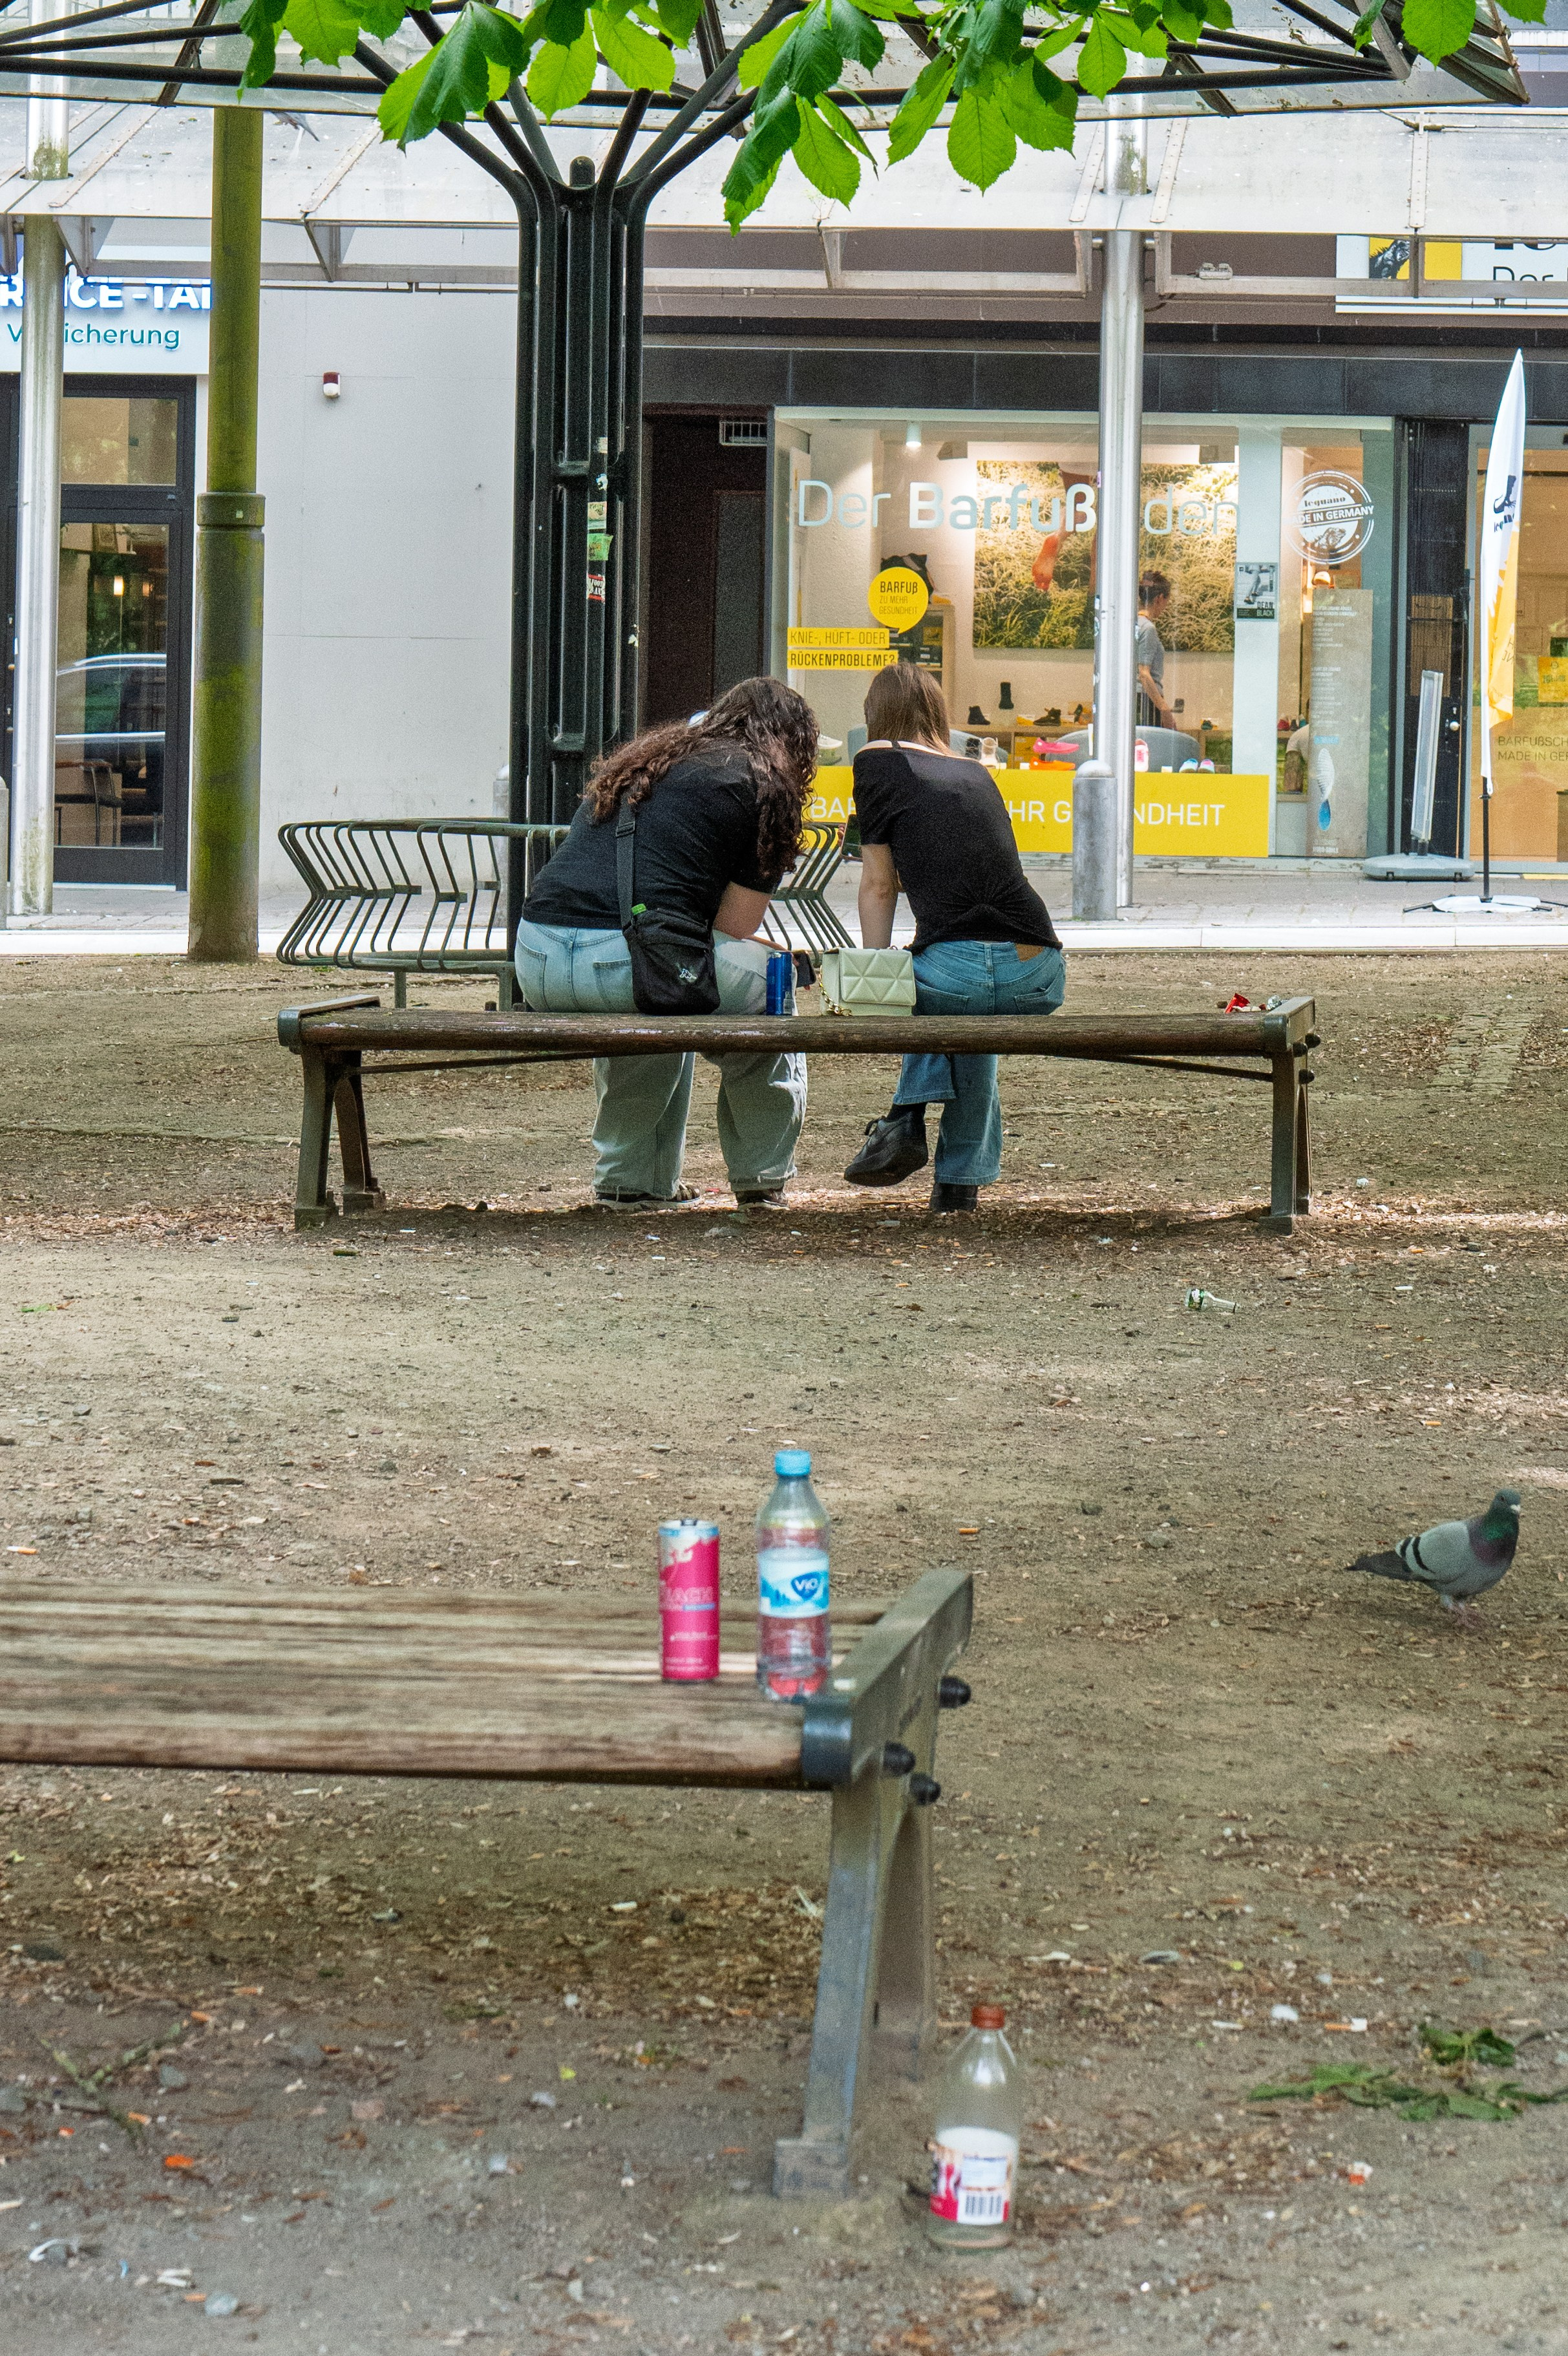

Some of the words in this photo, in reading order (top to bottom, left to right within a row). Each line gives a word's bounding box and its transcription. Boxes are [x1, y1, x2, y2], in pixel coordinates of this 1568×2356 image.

[7, 323, 179, 349] Vicherung
[798, 480, 891, 528] Der
[1313, 512, 1324, 522] IN
[1326, 505, 1374, 520] GERMANY
[879, 606, 917, 615] GESUNDHEIT
[790, 631, 821, 645] KNIE-,
[825, 631, 855, 644] HÜFT-
[859, 632, 886, 644] ODER
[790, 652, 896, 666] RÜCKENPROBLEME?
[1498, 751, 1531, 761] MADE
[1534, 751, 1546, 761] IN
[1550, 751, 1568, 761] GE
